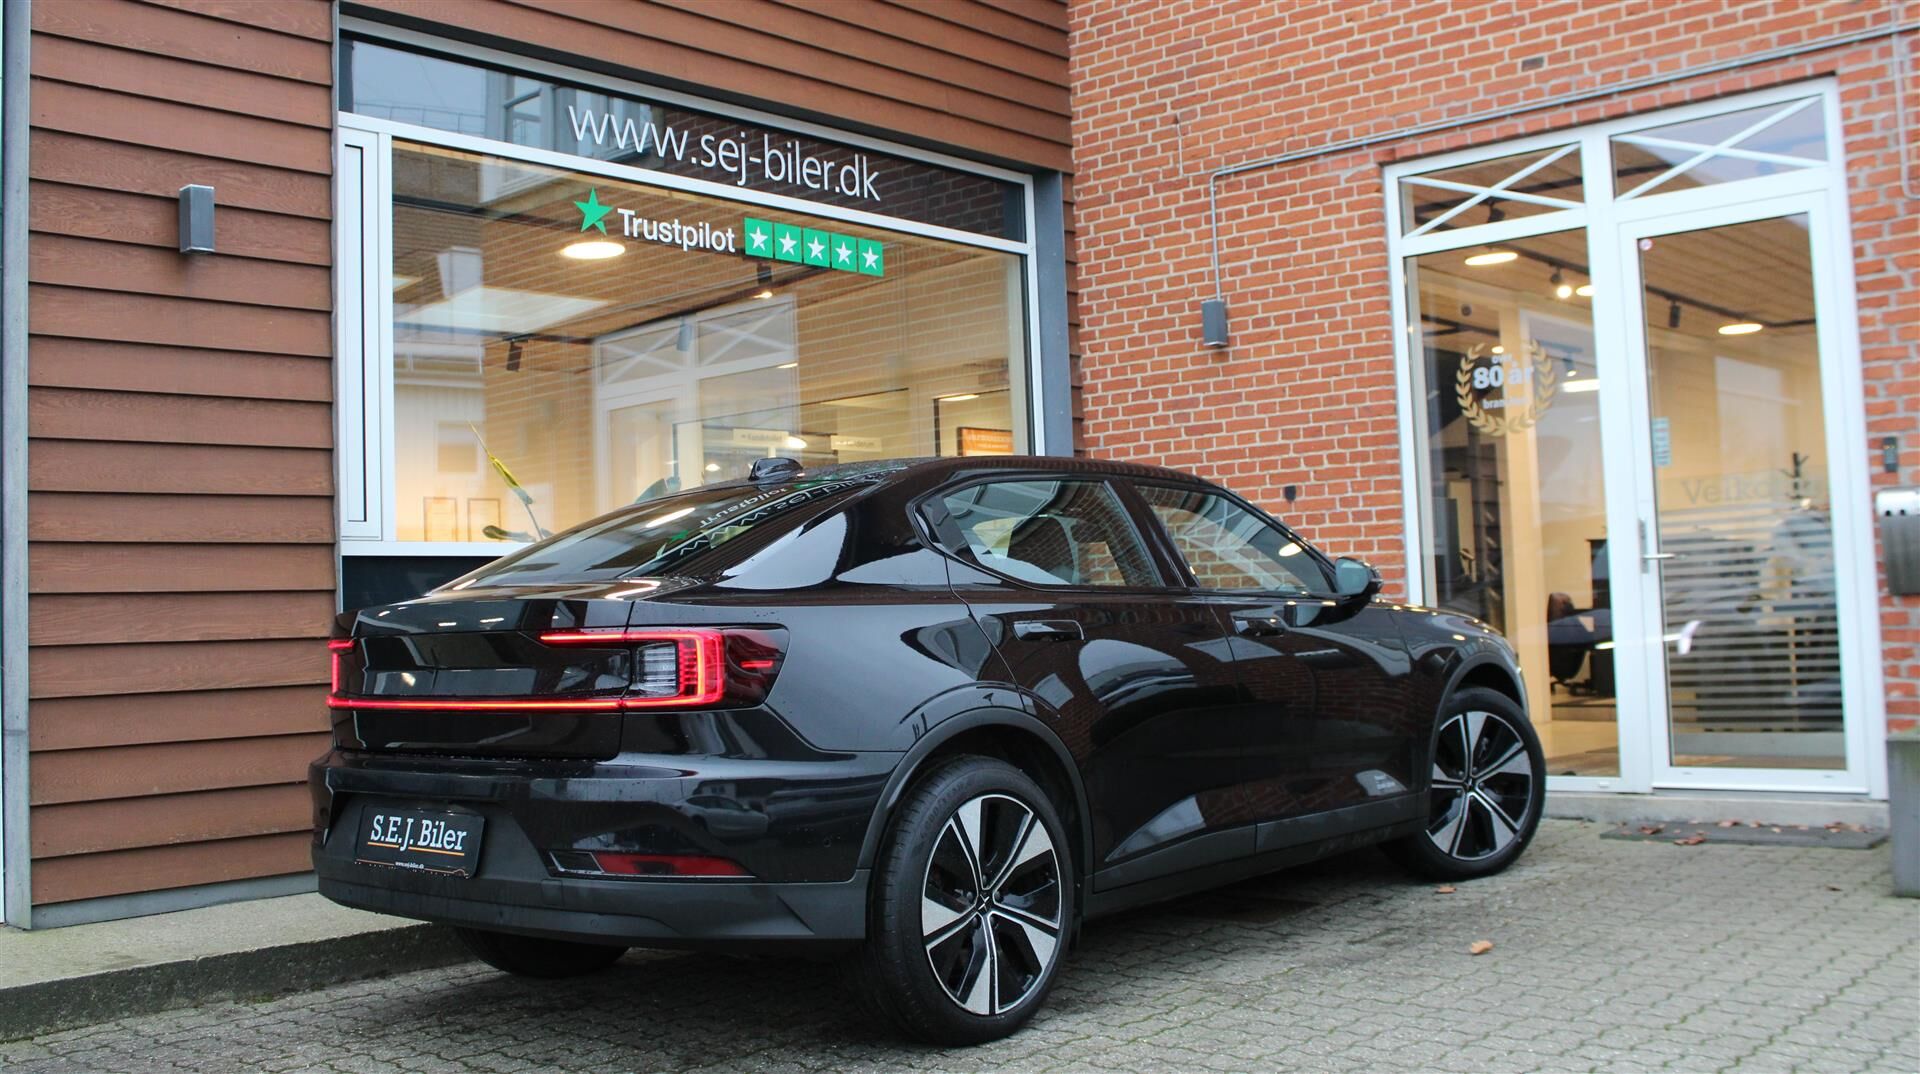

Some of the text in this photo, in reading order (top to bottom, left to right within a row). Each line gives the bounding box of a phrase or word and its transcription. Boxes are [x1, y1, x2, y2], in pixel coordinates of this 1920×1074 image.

[567, 105, 881, 202] www.sej-biler.dk
[617, 207, 736, 252] Trustpilot
[1473, 365, 1504, 389] 80
[370, 814, 468, 852] S.E.J. Biler
